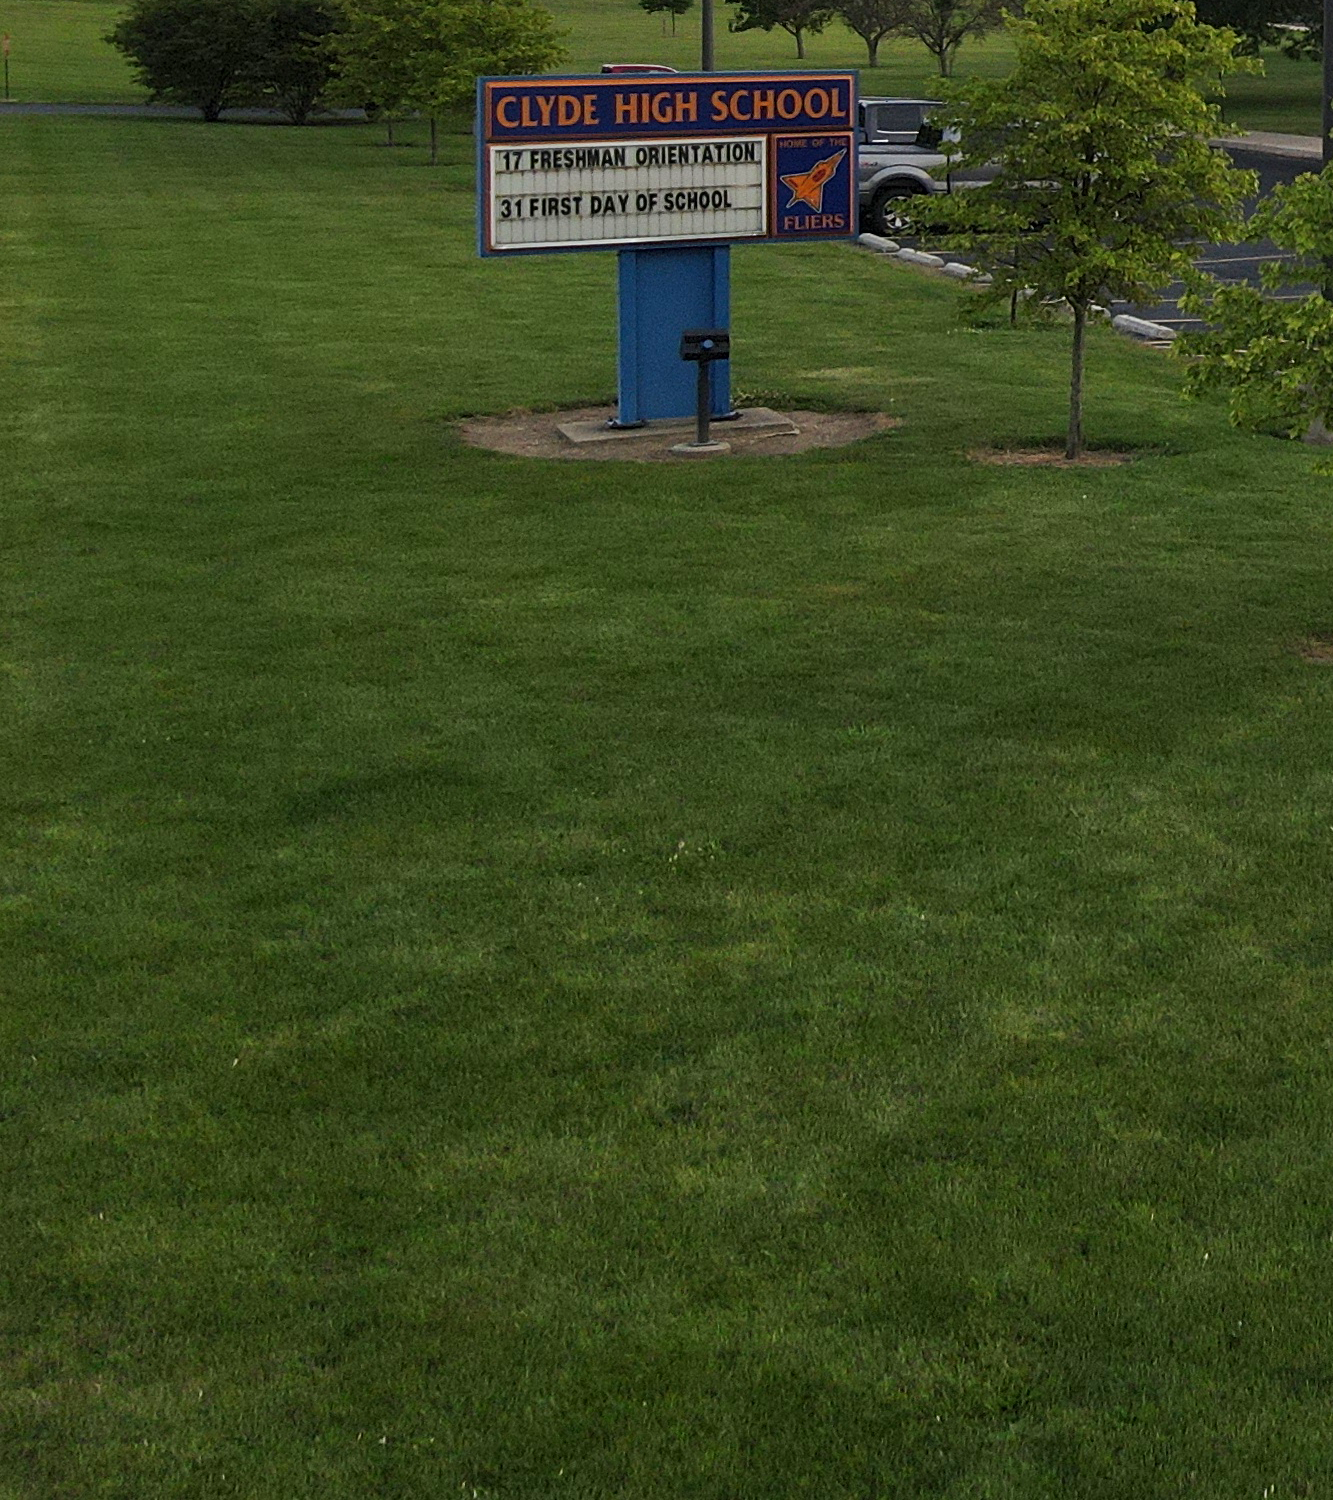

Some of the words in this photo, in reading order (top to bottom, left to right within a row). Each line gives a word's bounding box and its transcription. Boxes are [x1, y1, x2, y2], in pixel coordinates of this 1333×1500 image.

[496, 94, 599, 128] CLYDE
[614, 91, 698, 125] HIGH
[711, 87, 847, 121] SCHOOL
[502, 151, 523, 171] 17
[530, 148, 626, 169] FRESHMAN
[635, 143, 755, 165] ORIENTATION
[501, 199, 522, 218] 31
[529, 196, 582, 217] FIRST
[590, 194, 629, 215] DAY
[635, 193, 658, 212] OF
[664, 190, 732, 211] SCHOOL
[784, 213, 845, 230] FLIERS
